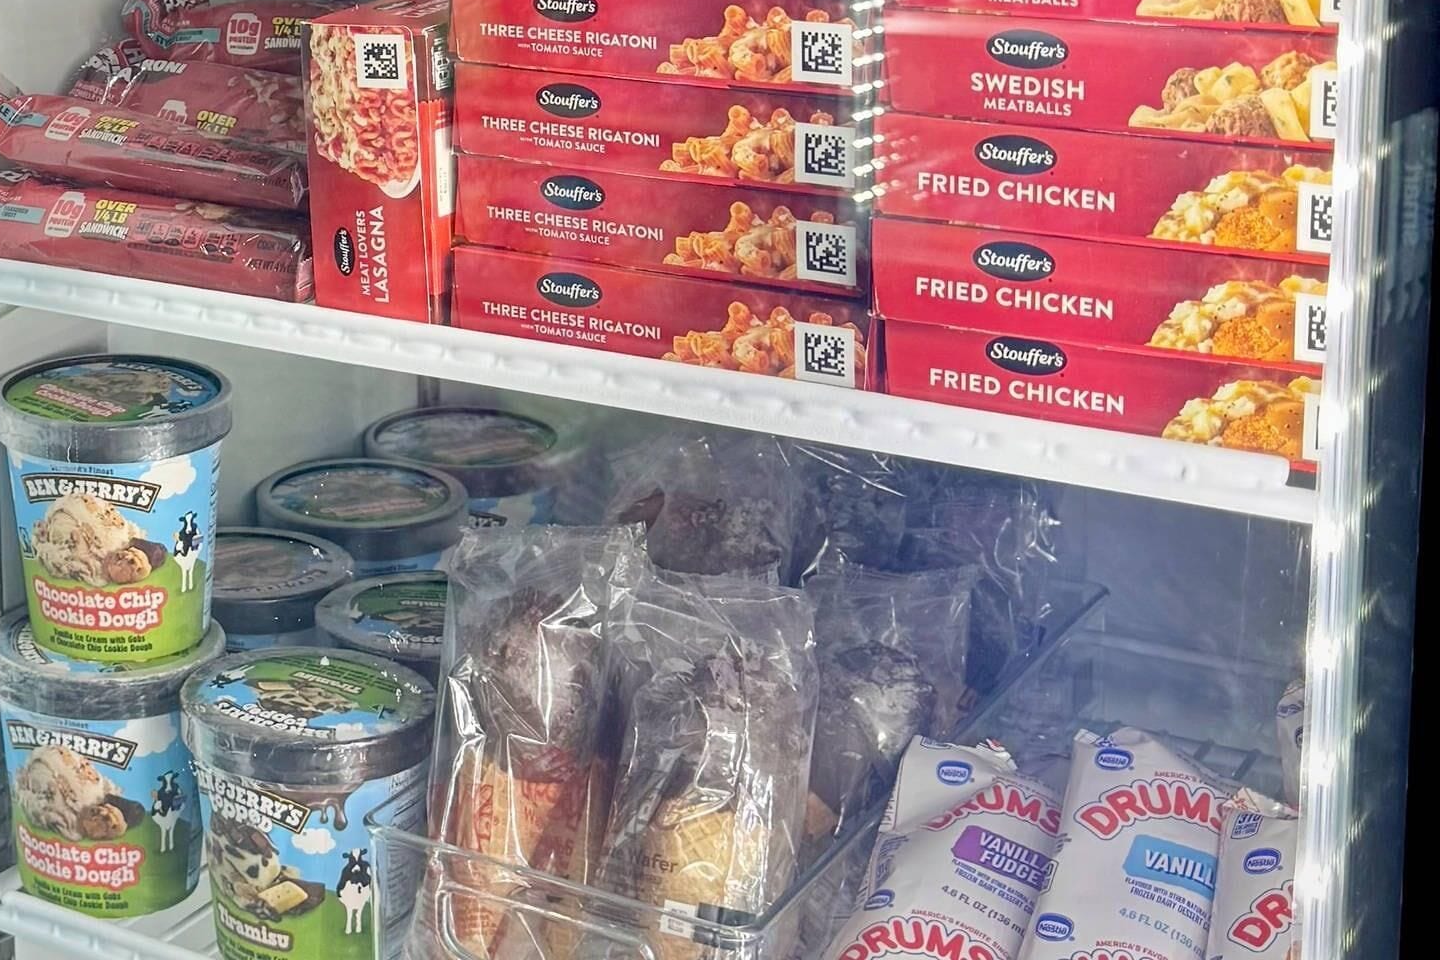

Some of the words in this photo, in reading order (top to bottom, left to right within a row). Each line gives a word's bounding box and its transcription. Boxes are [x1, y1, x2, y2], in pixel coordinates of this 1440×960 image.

[230, 18, 260, 36] 10g
[479, 23, 523, 39] THREE
[527, 25, 581, 43] CHEESE
[585, 31, 657, 51] RIGATONI
[531, 43, 569, 56] TOMATO
[572, 46, 603, 57] SAUCE
[991, 38, 1065, 59] Stouffer's
[539, 90, 599, 110] Stouffer's
[971, 72, 1086, 101] SWEDISH
[196, 110, 238, 128] OVER
[983, 98, 1072, 116] MEATBALLS
[100, 116, 140, 127] OVER
[481, 115, 525, 132] THREE
[529, 120, 583, 136] CHEESE
[588, 125, 660, 148] RIGATONI
[78, 129, 128, 146] SANDWICH!
[533, 136, 572, 150] TOMATO
[575, 140, 605, 154] SAUCE
[979, 142, 1054, 166] Stouffer's
[543, 182, 603, 203] Stouffer's
[917, 171, 990, 197] FRIED
[998, 181, 1116, 213] CHICKEN
[55, 200, 84, 219] 10g
[95, 200, 137, 213] OVER
[112, 213, 127, 223] LB
[78, 221, 129, 240] SANDWICH!
[356, 210, 367, 255] LOVERS
[486, 205, 531, 223] THREE
[534, 210, 589, 230] CHEESE
[592, 219, 664, 241] RIGATONI
[538, 227, 577, 241] TOMATO
[579, 233, 610, 246] SAUCE
[339, 229, 350, 274] Stouffer's
[368, 205, 390, 304] LASAGNA
[977, 249, 1052, 272] Stouffer's
[360, 258, 371, 297] MEAT
[539, 278, 600, 300] Stouffer's
[915, 277, 988, 303] FRIED
[996, 286, 1114, 320] CHICKEN
[482, 301, 527, 320] THREE
[530, 308, 585, 327] CHEESE
[588, 316, 661, 339] RIGATONI
[534, 324, 573, 338] TOMATO
[576, 330, 606, 344] SAUCE
[990, 342, 1064, 366] Stouffer's
[929, 367, 1001, 396] FRIED
[1008, 379, 1125, 415] CHICKEN
[26, 479, 58, 497] BEN
[74, 480, 153, 506] JERRY'S
[35, 579, 116, 609] Chocolate
[118, 590, 164, 608] Chip
[41, 600, 96, 627] Cookie
[99, 608, 159, 631] Dough
[86, 635, 107, 643] Cream
[87, 644, 101, 652] Chip
[104, 644, 128, 652] Cookie
[130, 644, 152, 652] Dough
[18, 824, 91, 865] Chocolate
[94, 845, 141, 865] Chip
[980, 832, 1053, 875] VANILLA
[24, 849, 71, 880] Cookie
[75, 863, 134, 887] Dough
[980, 851, 1039, 884] FUDGE
[1145, 849, 1214, 888] VANILL
[942, 885, 957, 897] 4.6
[959, 893, 970, 905] FL
[973, 901, 988, 913] OZ
[1130, 887, 1155, 901] FROZEN
[1156, 895, 1176, 911] DAIRY
[1178, 904, 1203, 925] DESSERT
[218, 902, 289, 948] Tiramisu
